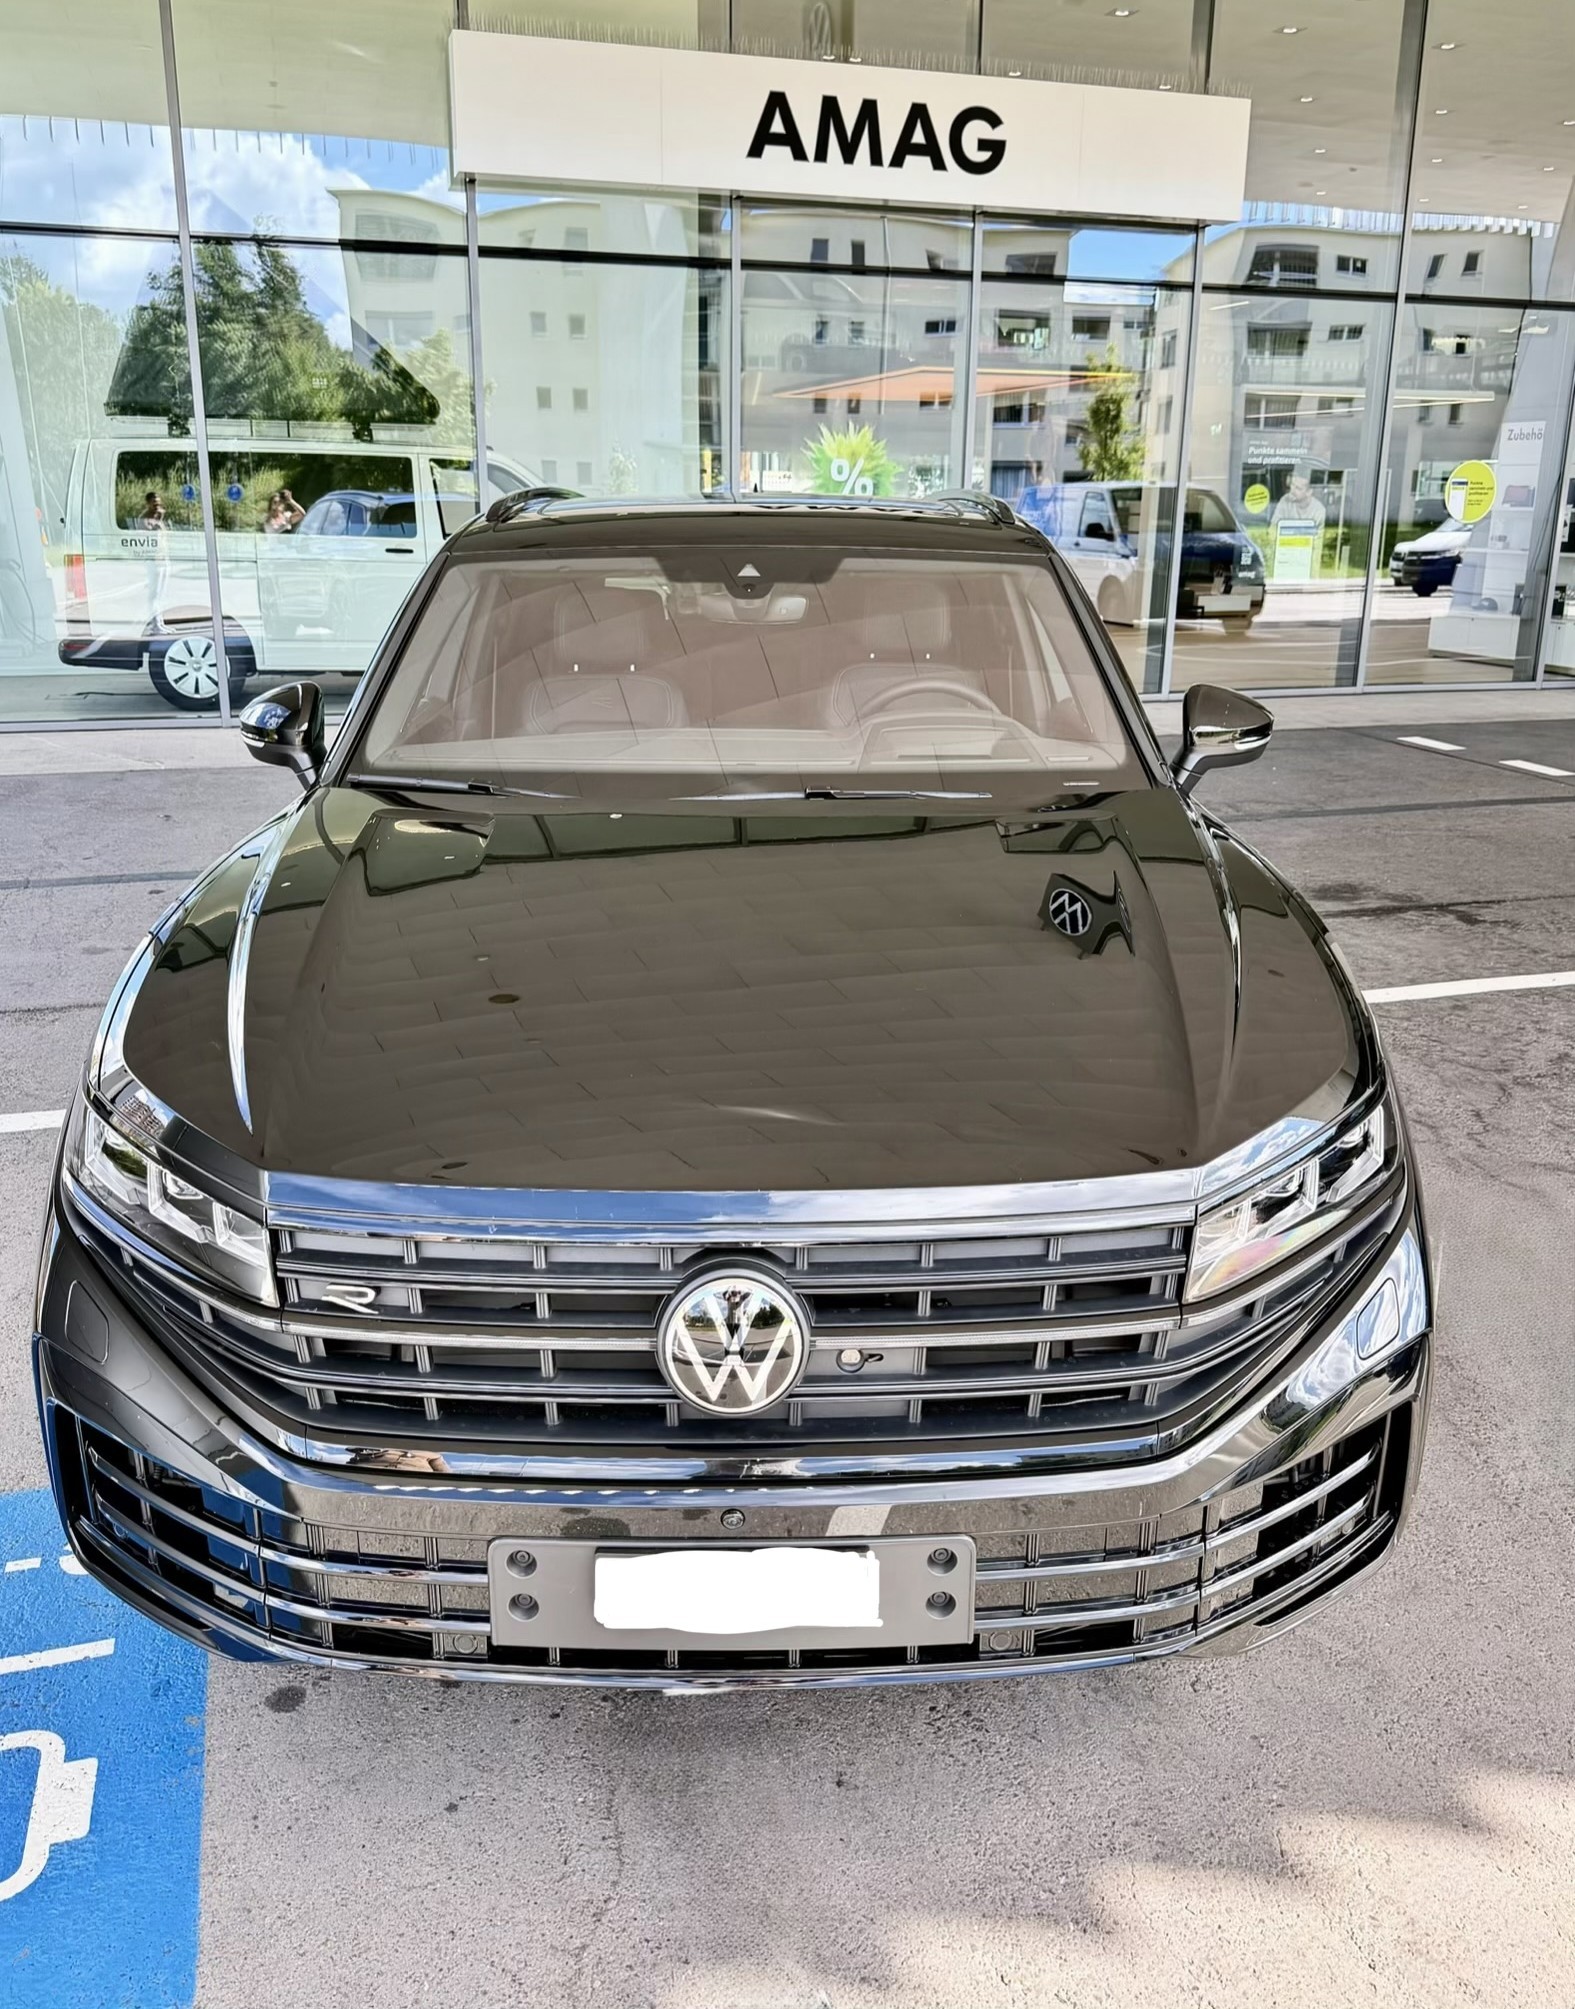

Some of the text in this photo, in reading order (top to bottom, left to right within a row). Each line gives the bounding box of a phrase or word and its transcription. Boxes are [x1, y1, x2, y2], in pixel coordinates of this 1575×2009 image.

[745, 90, 1007, 175] AMAG
[121, 536, 158, 548] envia
[664, 1277, 805, 1414] VW
